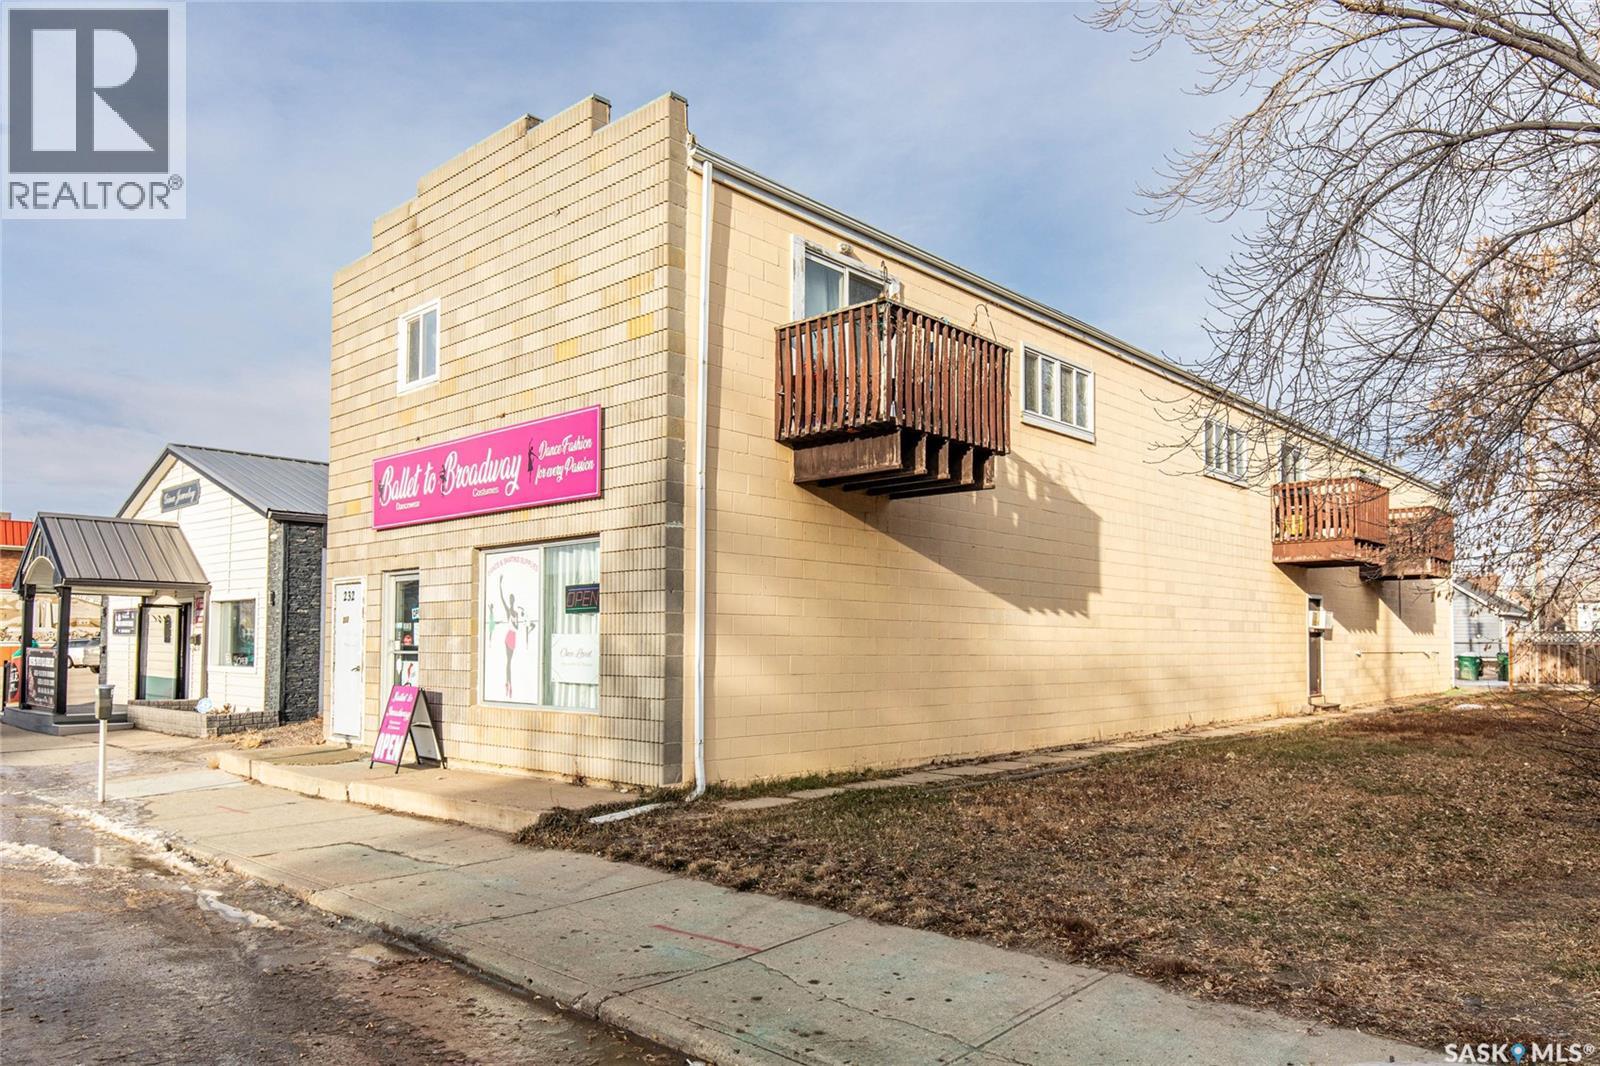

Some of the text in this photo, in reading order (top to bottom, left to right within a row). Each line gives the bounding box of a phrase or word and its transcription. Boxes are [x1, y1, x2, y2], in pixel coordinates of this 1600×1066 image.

[538, 434, 593, 460] Dance Fashion
[380, 447, 522, 506] Ballet to Broadway
[535, 456, 594, 486] for every Passion
[343, 590, 355, 602] 232
[566, 590, 599, 608] OPEN
[374, 733, 404, 761] OPEN
